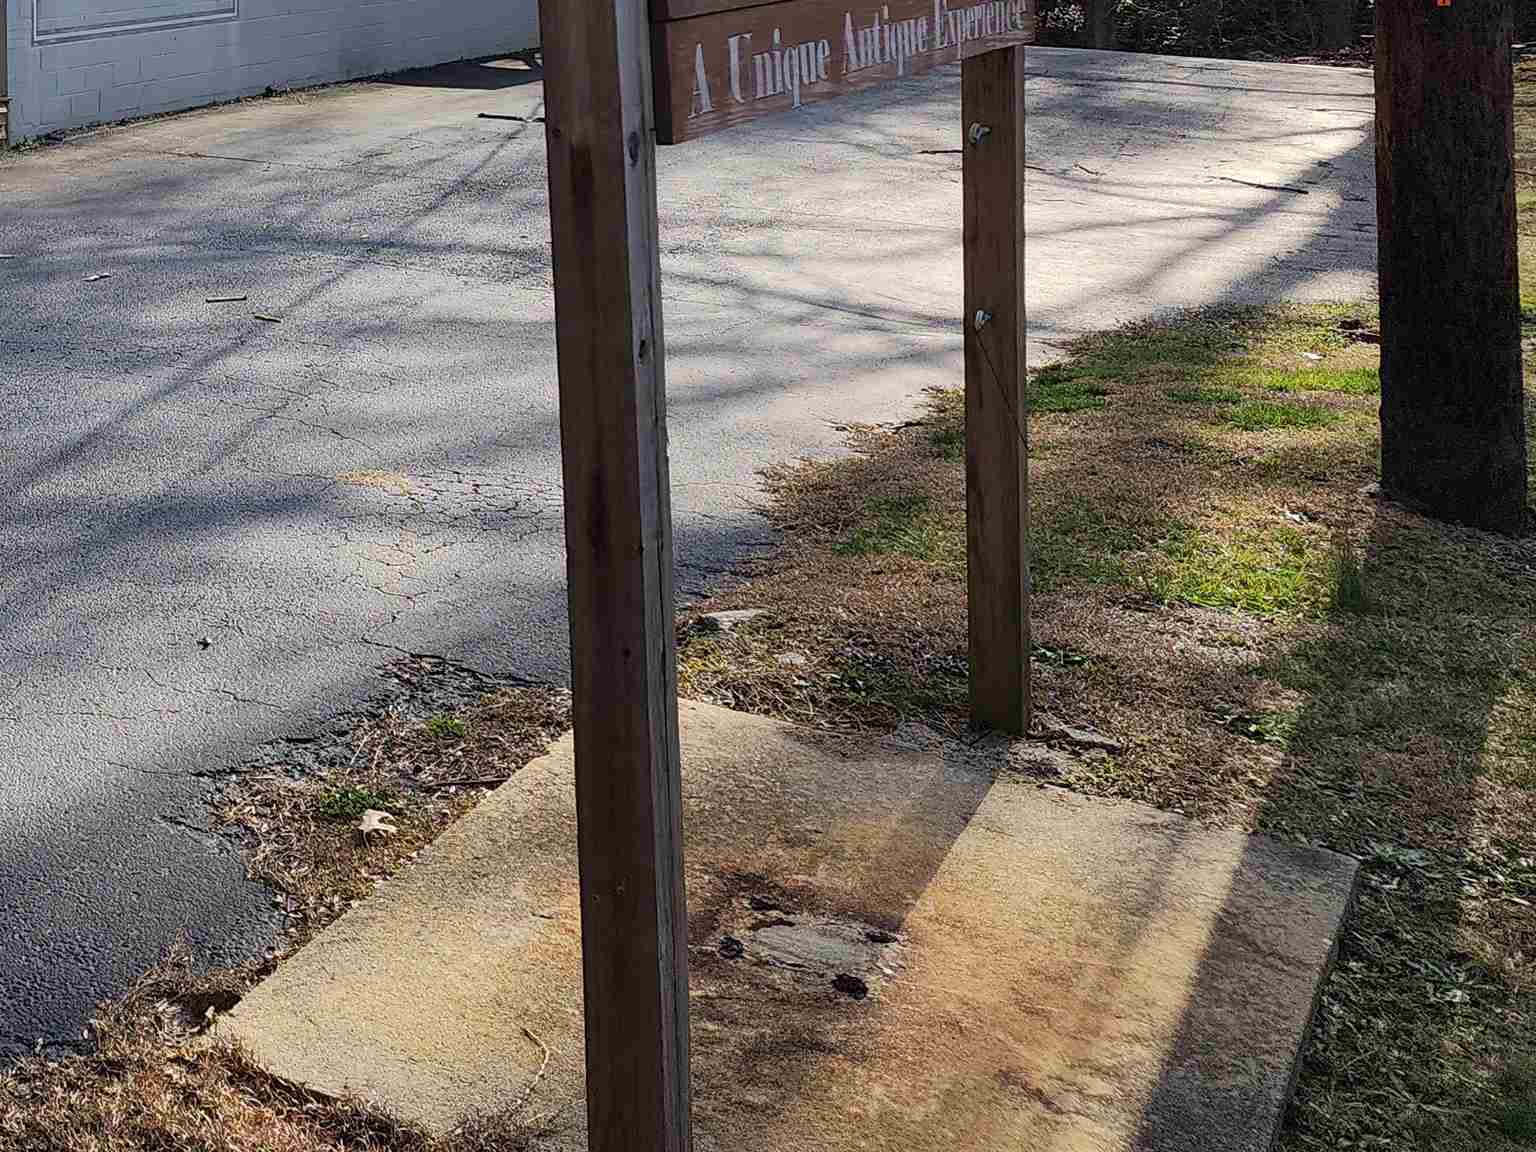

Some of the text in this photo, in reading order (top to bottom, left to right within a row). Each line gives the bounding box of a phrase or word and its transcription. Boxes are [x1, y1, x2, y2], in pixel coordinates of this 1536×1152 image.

[687, 41, 715, 119] A
[727, 27, 831, 110] Unique
[841, 4, 929, 76] Antique
